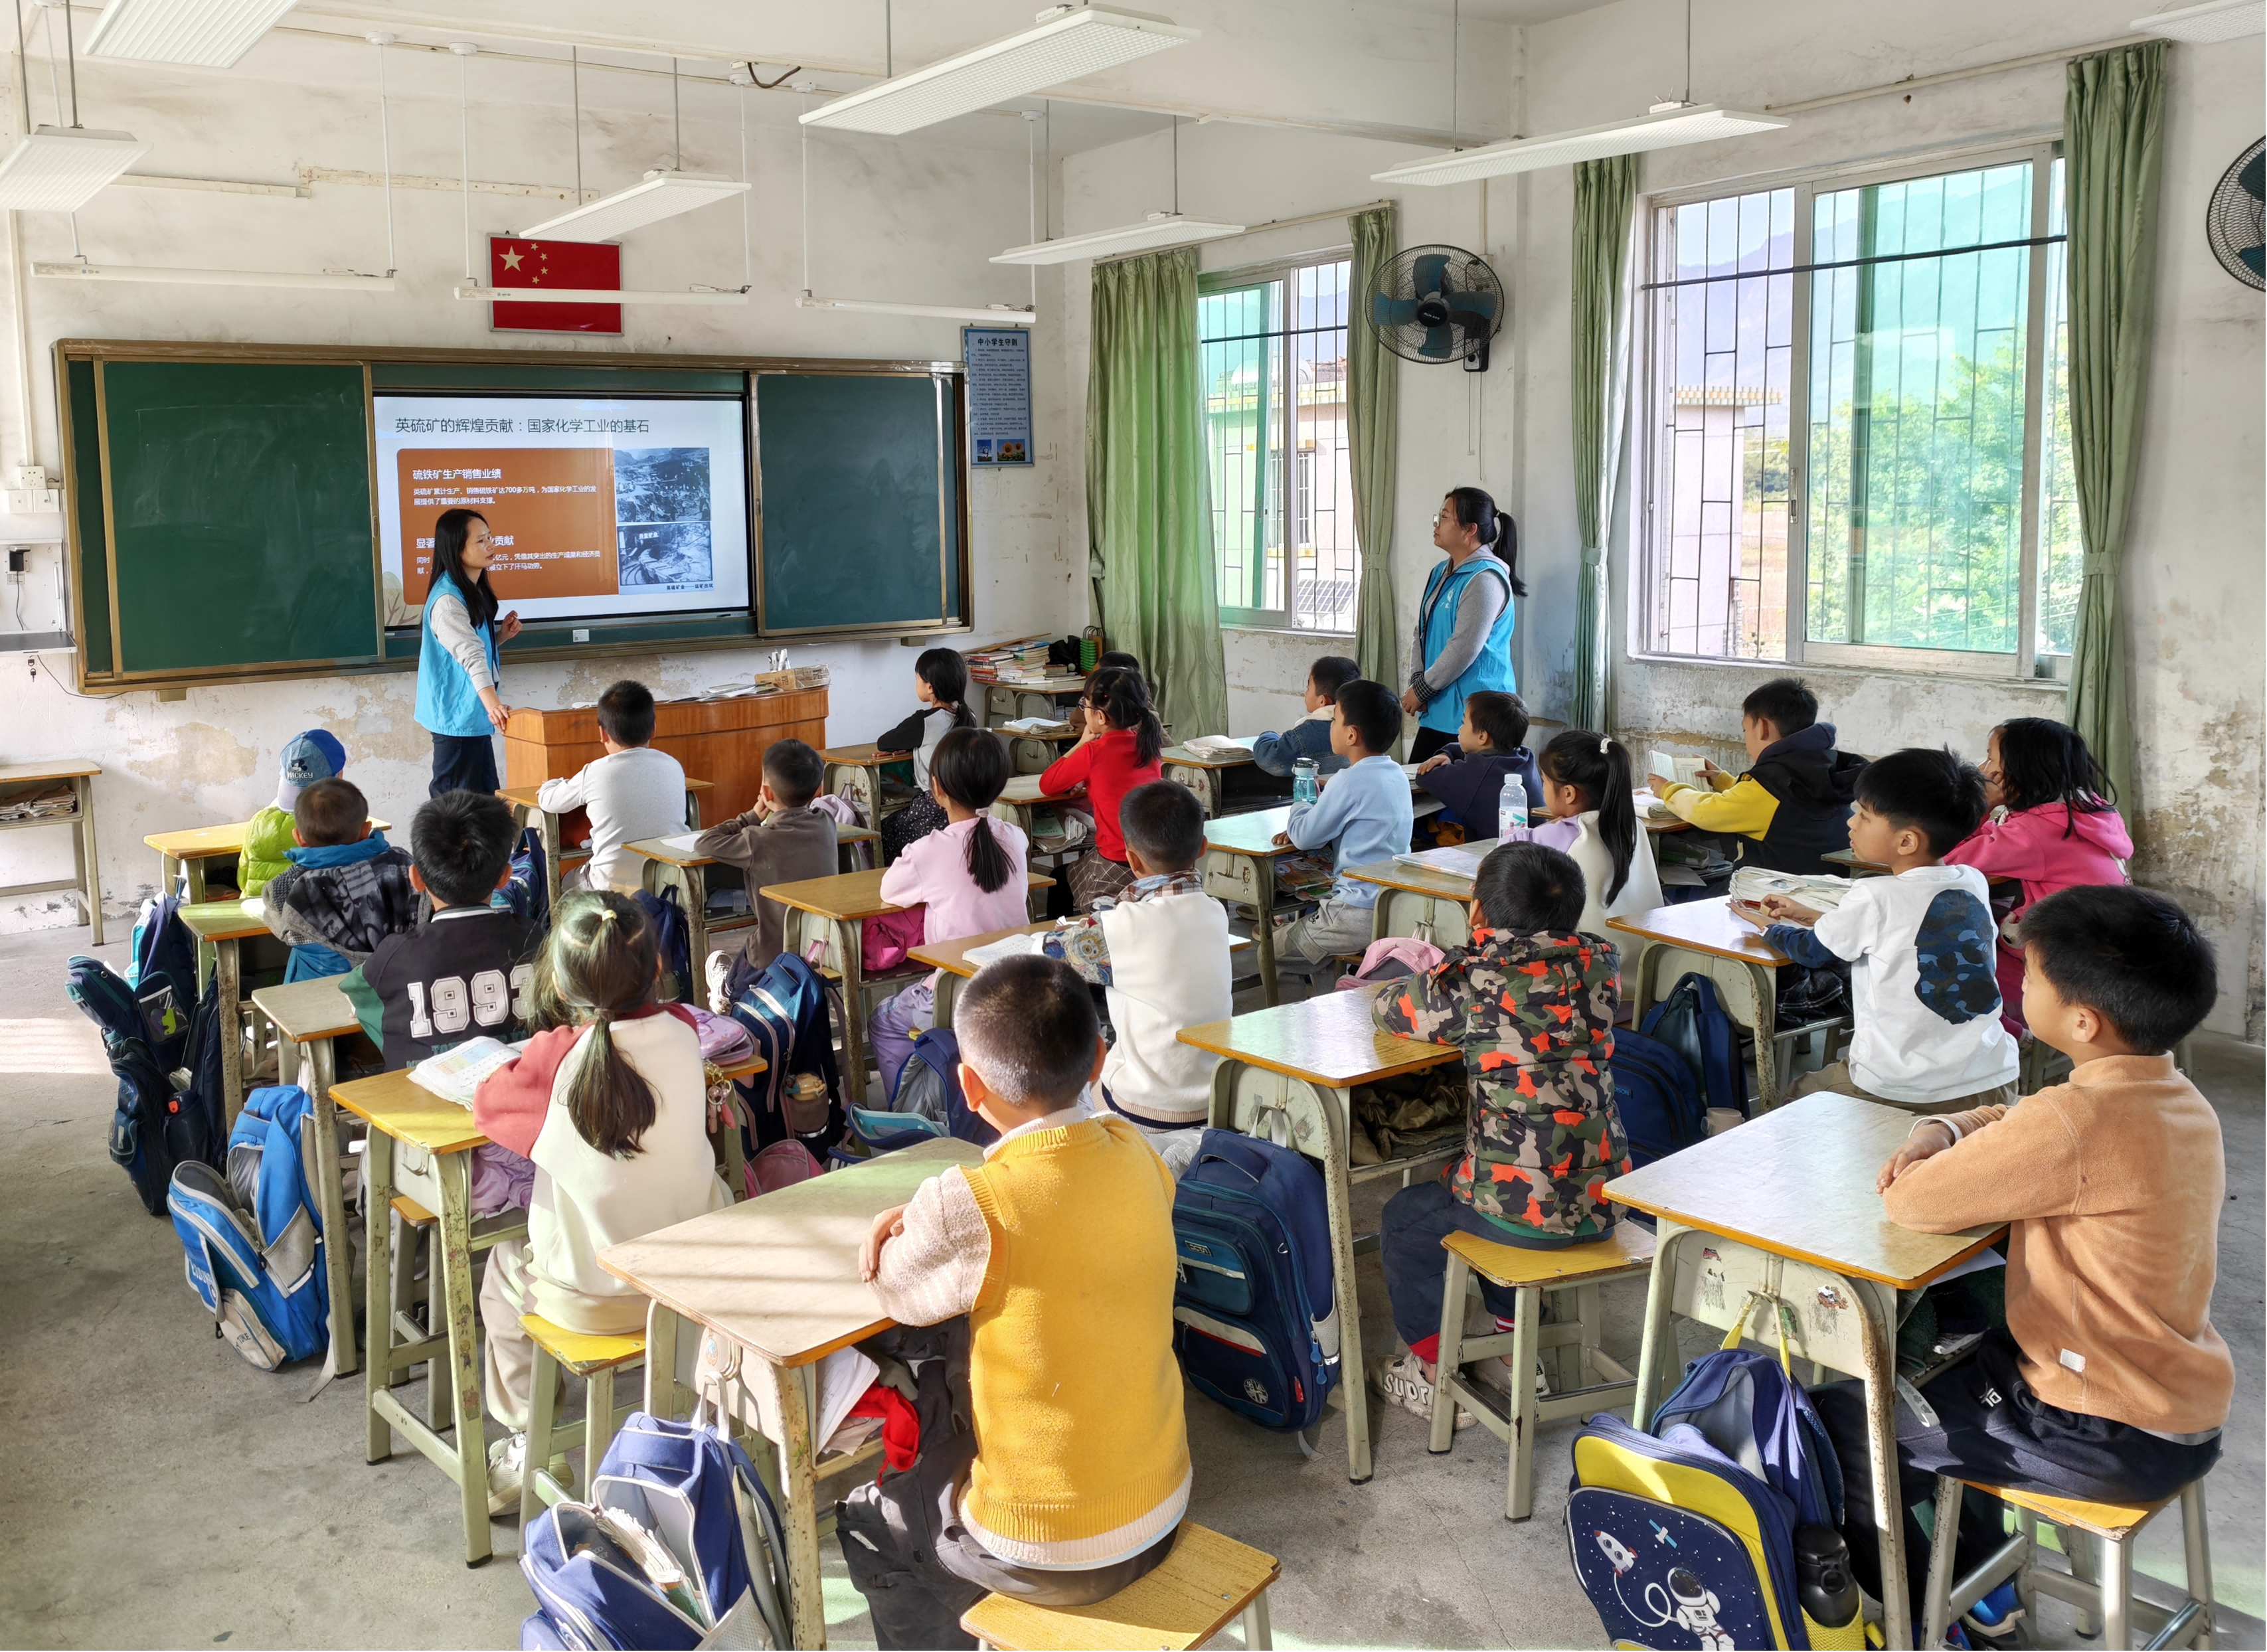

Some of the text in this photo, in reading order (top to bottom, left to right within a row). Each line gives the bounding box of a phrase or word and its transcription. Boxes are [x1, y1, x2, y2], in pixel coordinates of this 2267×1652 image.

[977, 337, 1018, 347] 中小学生守则
[395, 418, 649, 433] 英硫矿的辉煌贡献：国家化学工业的基石
[412, 468, 501, 480] 硫铁矿生产销售业绩
